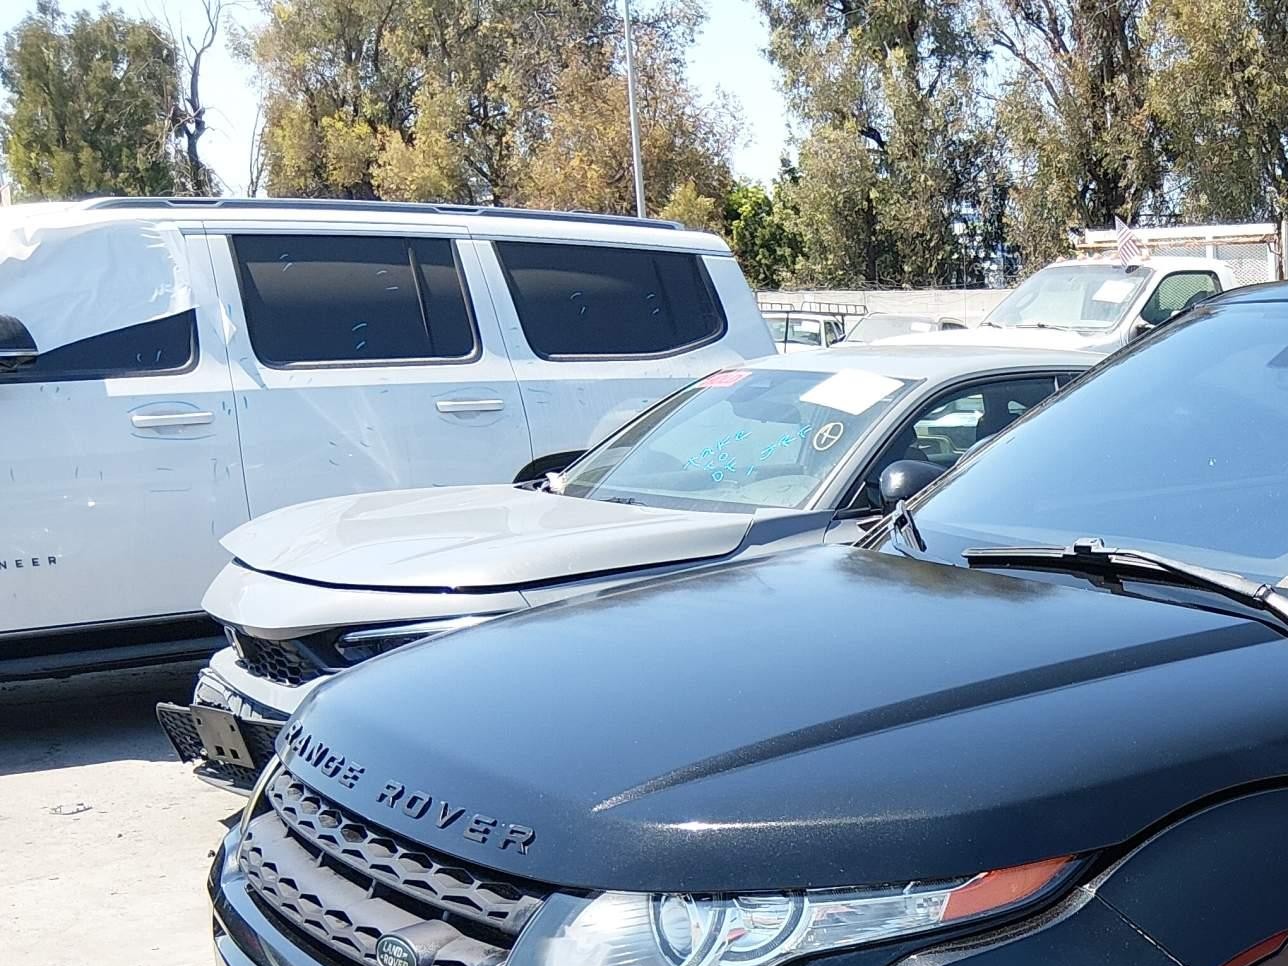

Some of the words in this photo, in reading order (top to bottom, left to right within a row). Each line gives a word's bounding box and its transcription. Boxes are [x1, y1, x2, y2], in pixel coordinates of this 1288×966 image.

[283, 719, 365, 790] RANGE
[375, 778, 538, 856] ROVER
[382, 941, 403, 957] LAND
